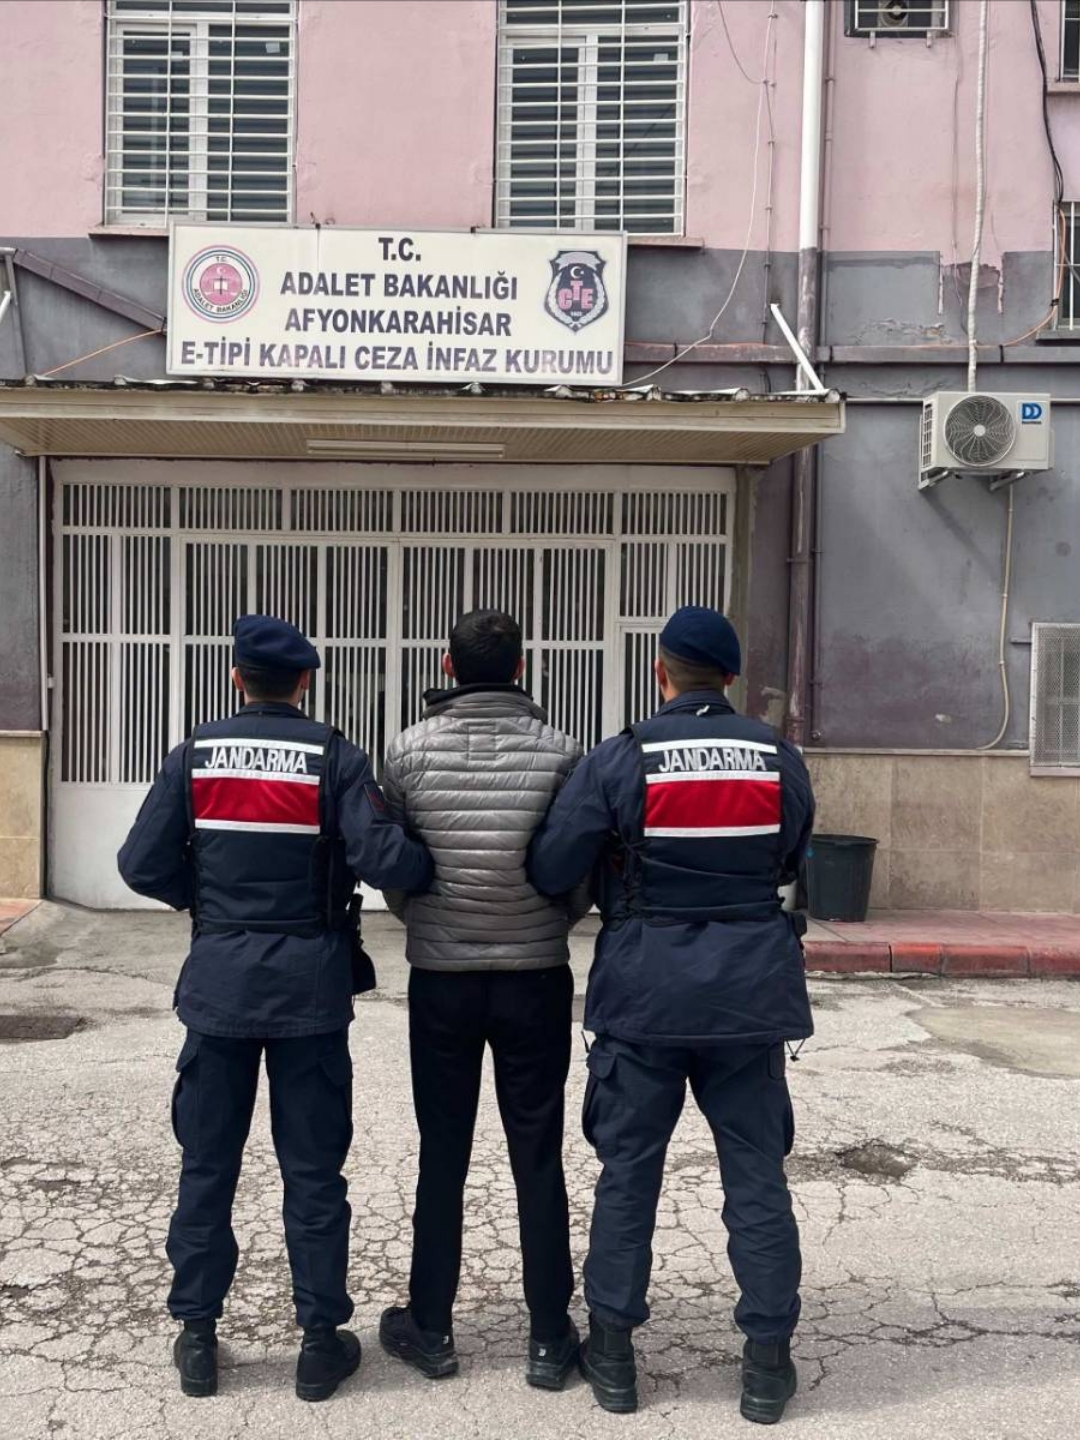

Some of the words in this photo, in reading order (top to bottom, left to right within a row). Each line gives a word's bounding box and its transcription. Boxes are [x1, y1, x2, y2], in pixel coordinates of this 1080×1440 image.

[379, 237, 421, 261] T.C.
[280, 271, 376, 297] ADALET
[384, 270, 517, 300] BAKANLIĞI
[558, 280, 593, 309] CTE
[285, 306, 511, 336] AFYONKARAHİSAR
[181, 336, 251, 366] E-TİPİ
[259, 343, 346, 369] KAPALI
[355, 345, 419, 370] CEZA
[427, 341, 497, 372] İNFAZ
[505, 349, 613, 375] KURUMU
[205, 747, 307, 773] JANDARMA
[658, 748, 767, 772] JANDARMA
